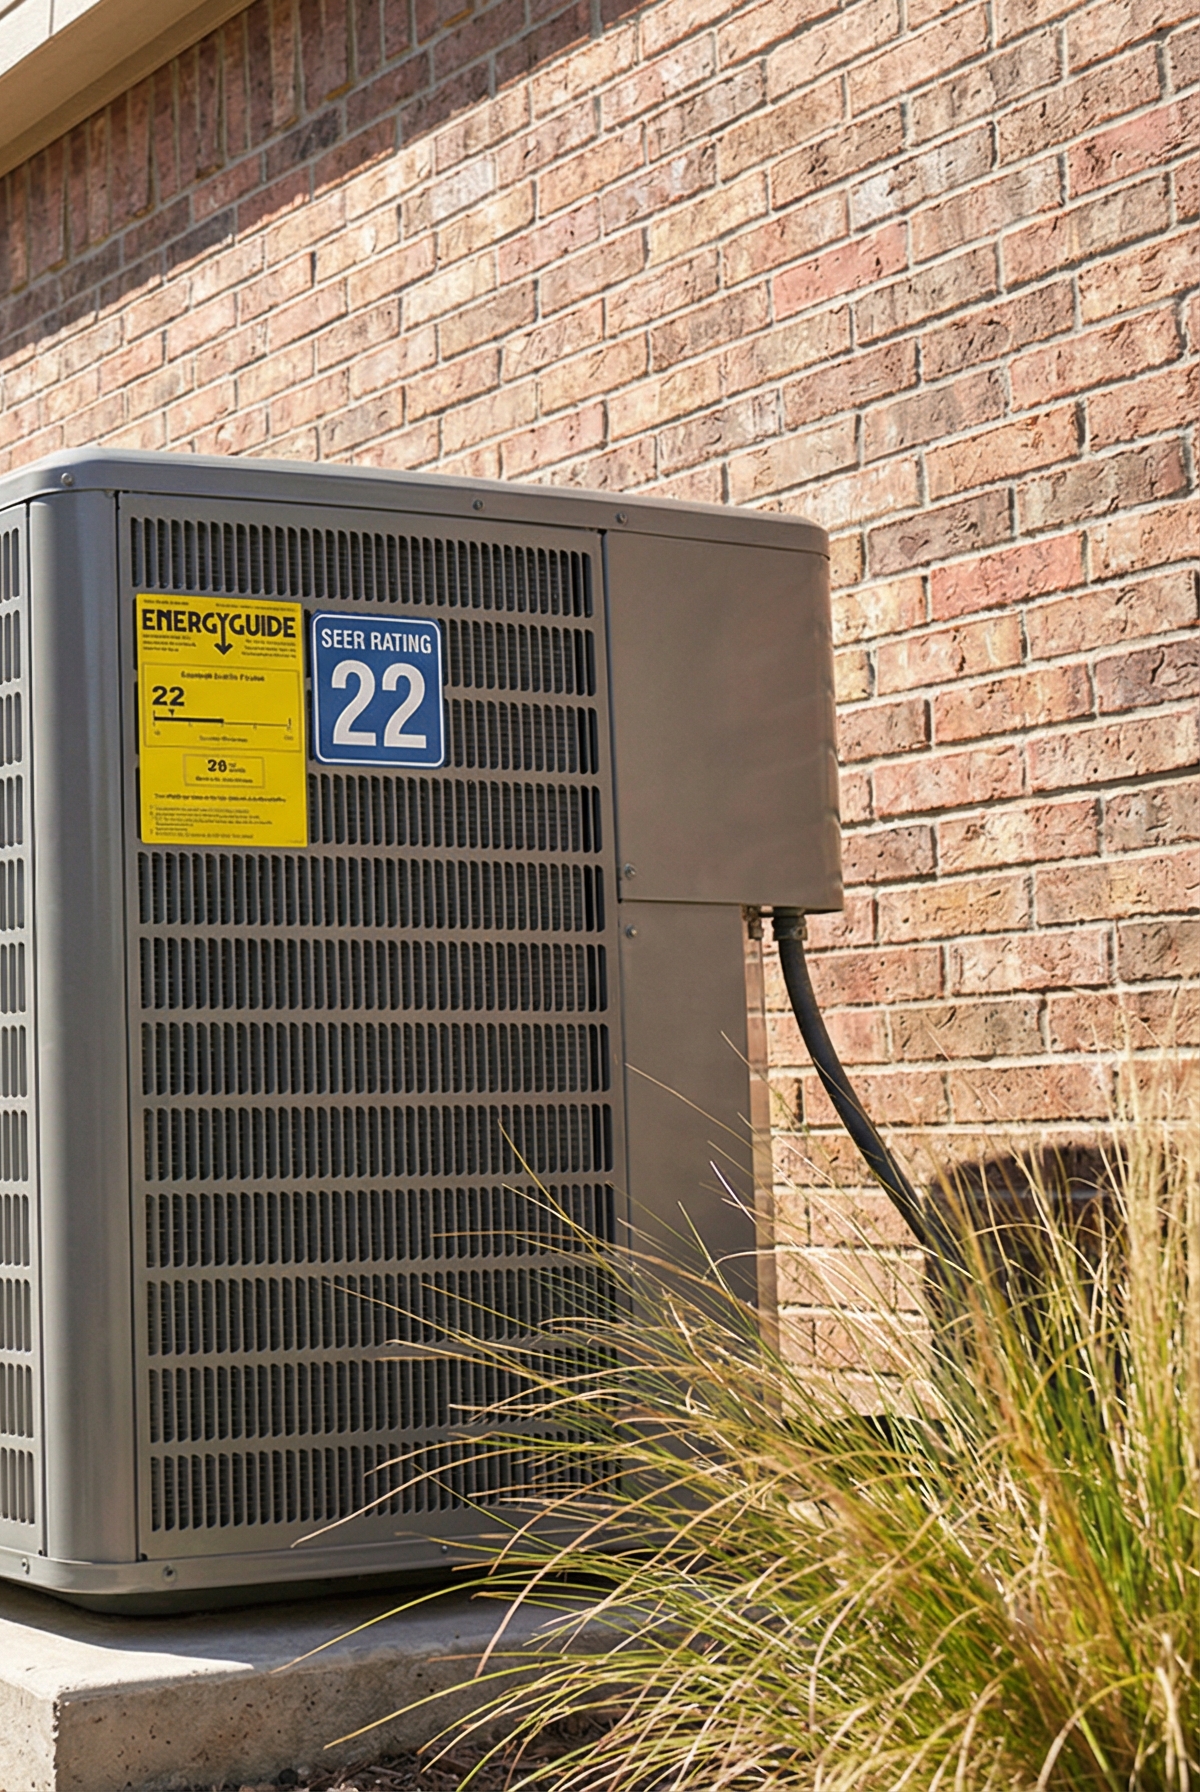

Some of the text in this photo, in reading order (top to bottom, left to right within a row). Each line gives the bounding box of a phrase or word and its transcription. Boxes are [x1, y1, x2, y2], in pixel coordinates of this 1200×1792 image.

[142, 609, 296, 638] ENERGYGUIDE
[322, 628, 366, 651] SEER
[371, 630, 431, 654] RATING
[152, 685, 185, 706] 22
[331, 659, 427, 749] 22
